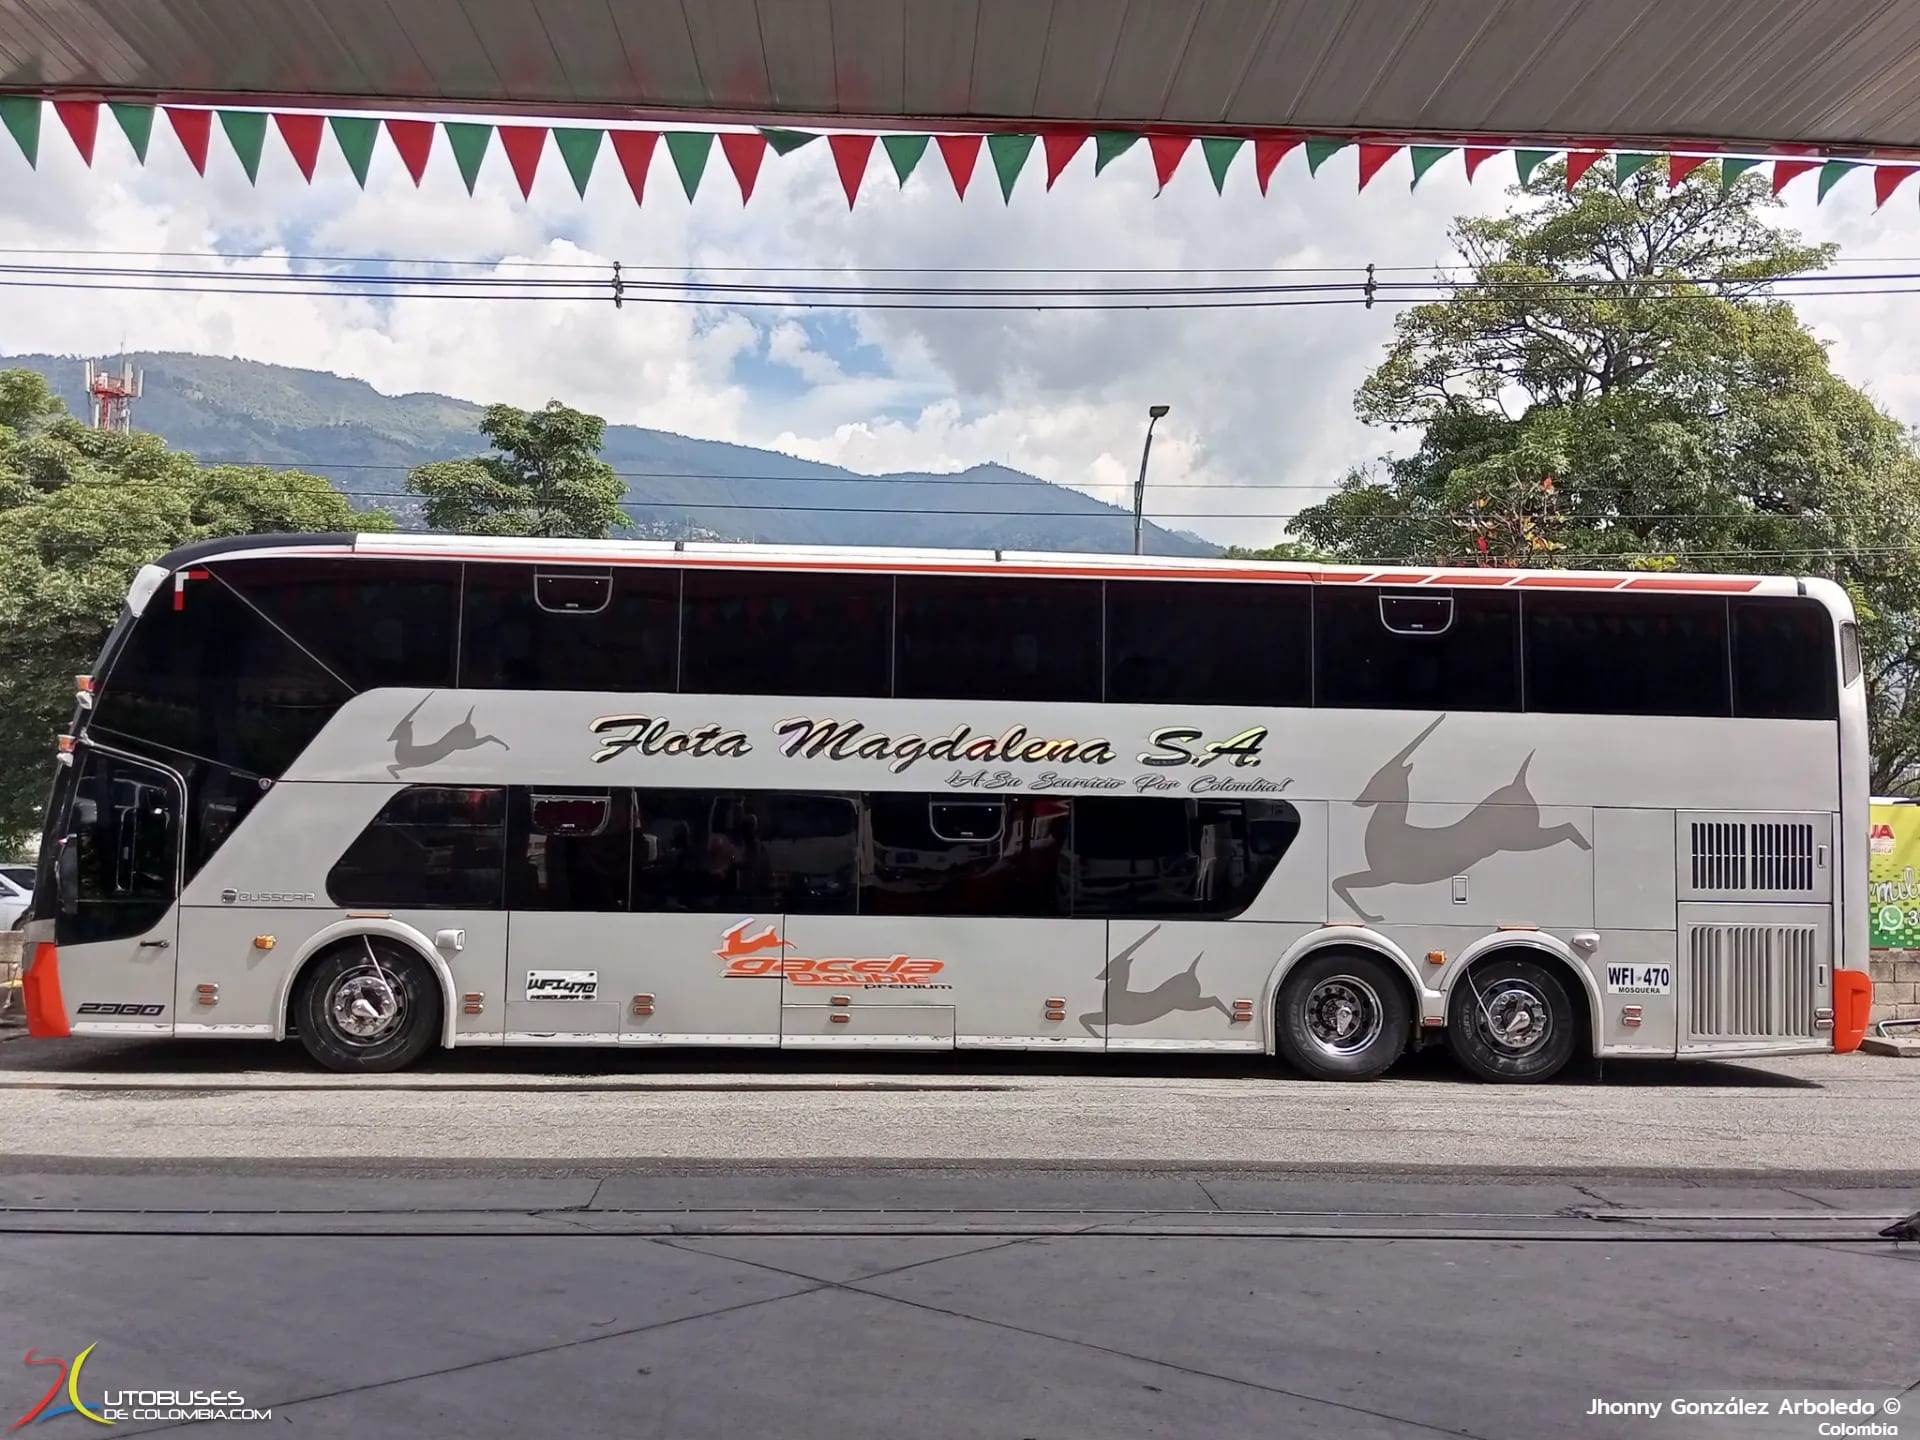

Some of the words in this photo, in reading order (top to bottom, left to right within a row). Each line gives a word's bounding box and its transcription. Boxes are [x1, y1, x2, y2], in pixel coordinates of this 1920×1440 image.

[588, 714, 753, 763] Flota
[773, 715, 1117, 774] Magdalena
[1136, 725, 1268, 767] S.A.
[983, 770, 1023, 789] Su
[1132, 773, 1181, 793] Por
[1188, 774, 1295, 793] Colombia!
[239, 892, 315, 902] BUSSCAR
[727, 953, 945, 975] gacela
[787, 971, 932, 984] Double
[1608, 967, 1634, 985] WFI
[1643, 968, 1669, 986] 470
